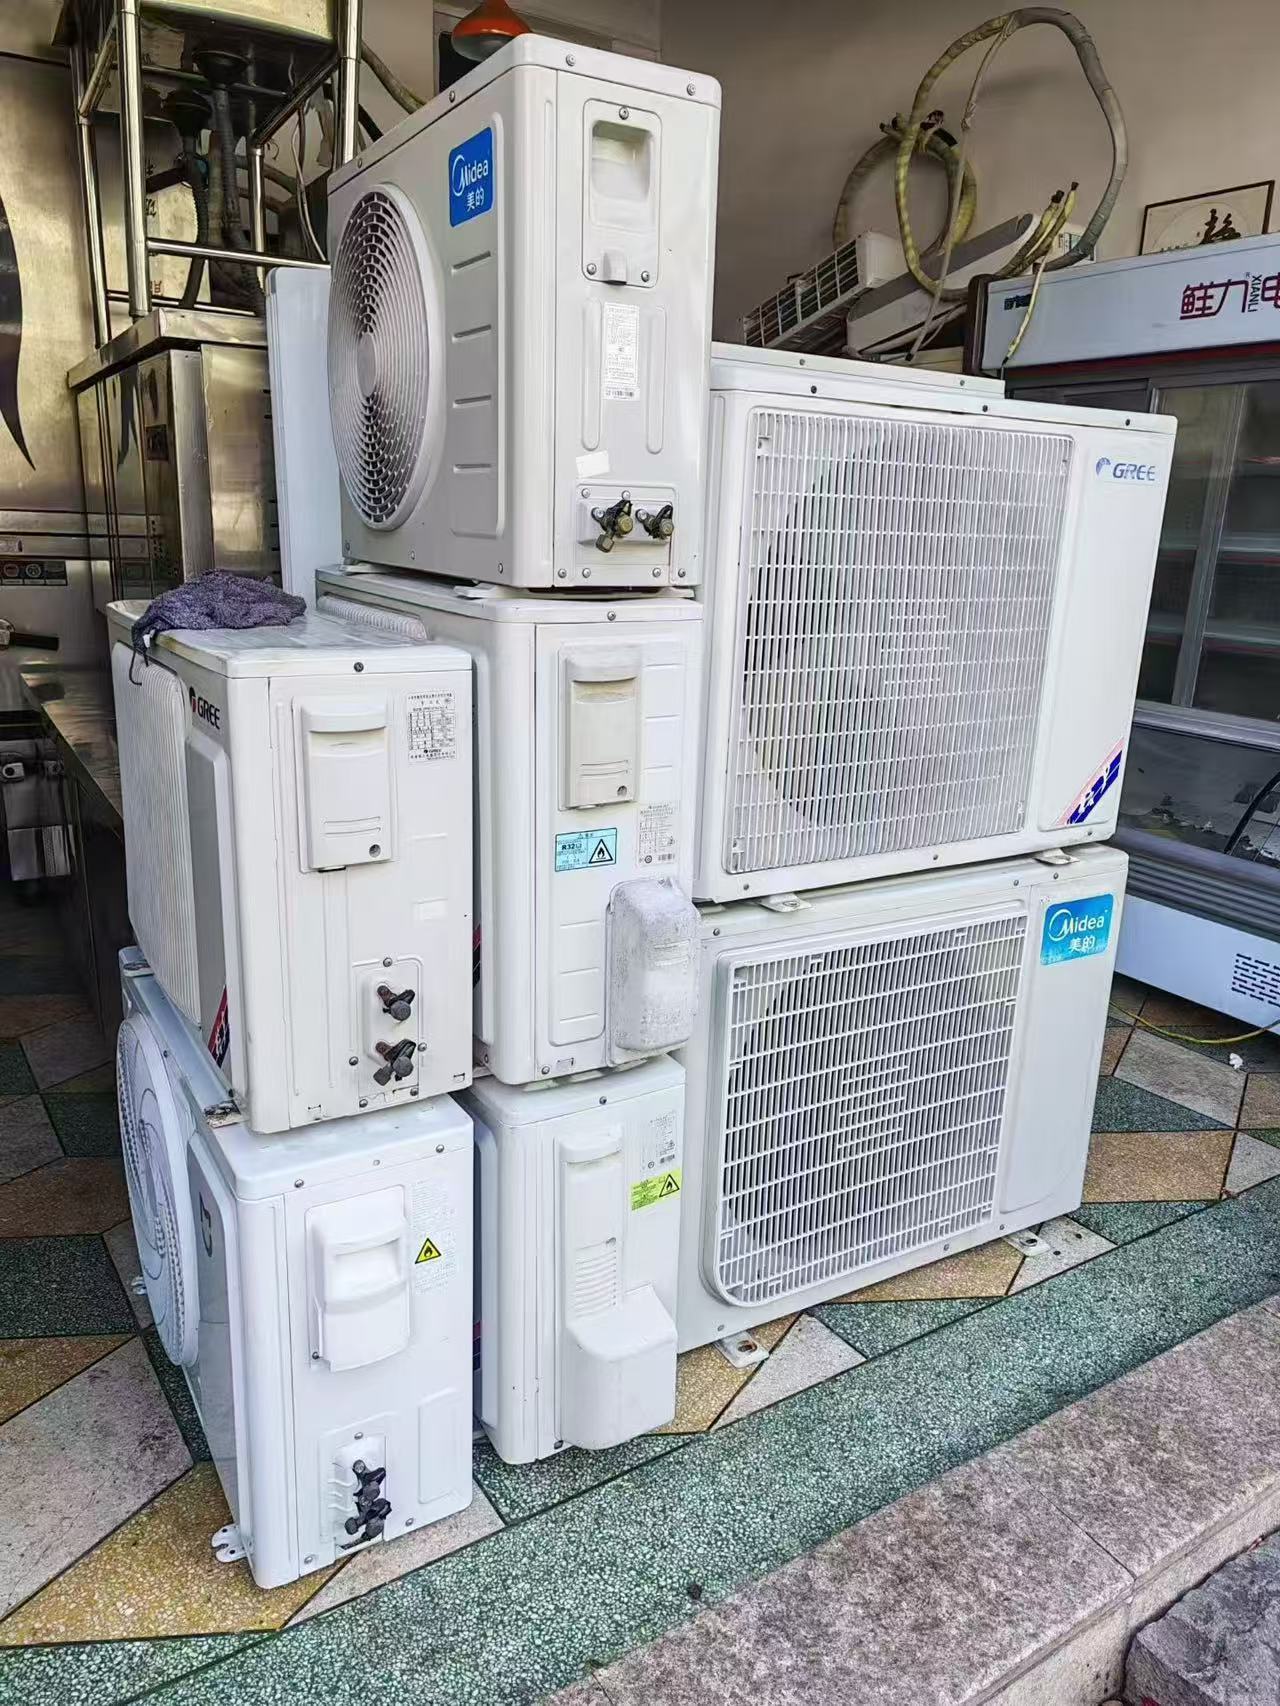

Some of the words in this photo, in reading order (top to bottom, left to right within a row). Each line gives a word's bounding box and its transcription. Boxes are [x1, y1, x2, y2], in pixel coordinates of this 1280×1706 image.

[452, 154, 489, 197] Midea
[466, 187, 485, 212] 美的
[1180, 279, 1249, 320] 鲜力
[1247, 274, 1262, 312] XIANLI
[1113, 463, 1155, 481] GREE
[197, 696, 220, 730] GREE
[1048, 908, 1105, 942] Midea
[1069, 935, 1096, 954] 美的
